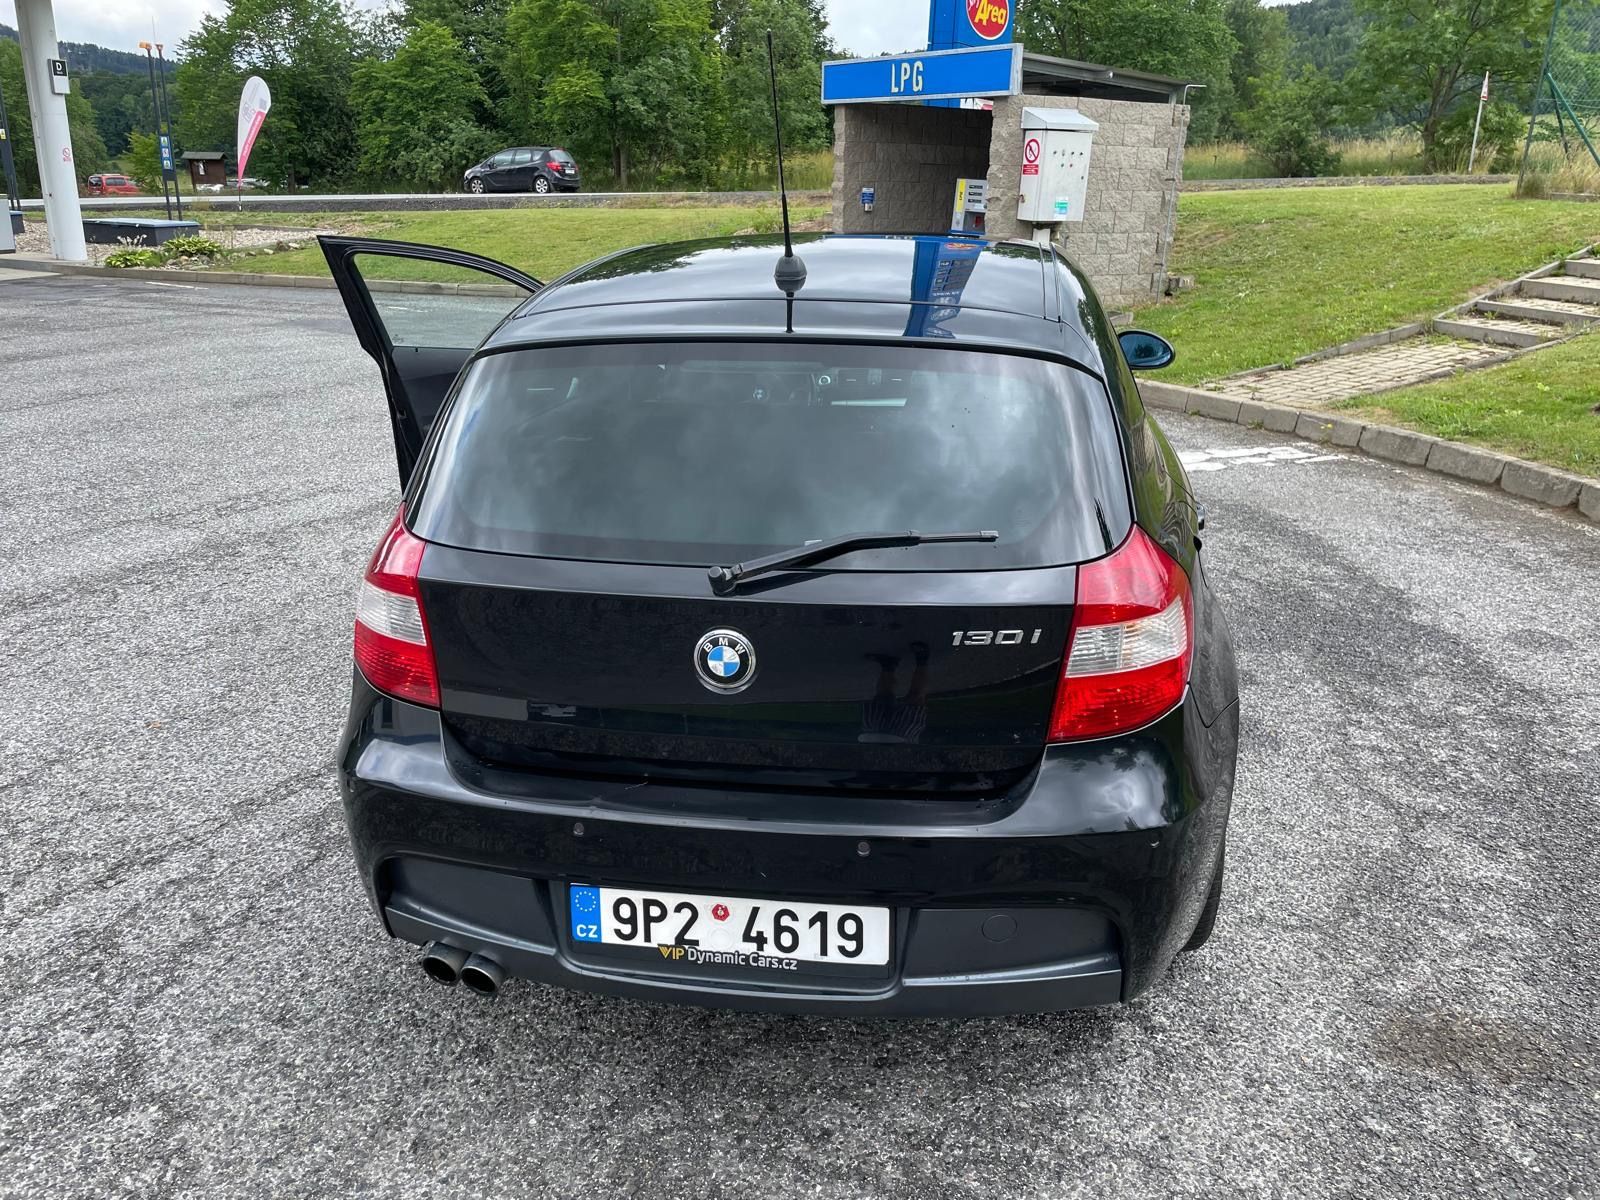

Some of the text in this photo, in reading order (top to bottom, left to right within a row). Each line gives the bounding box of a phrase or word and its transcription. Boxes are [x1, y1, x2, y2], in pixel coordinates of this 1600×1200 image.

[974, 0, 1007, 26] Area
[891, 60, 924, 93] LPG
[703, 636, 746, 655] BMW
[576, 924, 598, 938] CZ
[612, 896, 864, 958] 9P2 4619
[657, 944, 798, 970] VIP Dynamic Cars.cz
